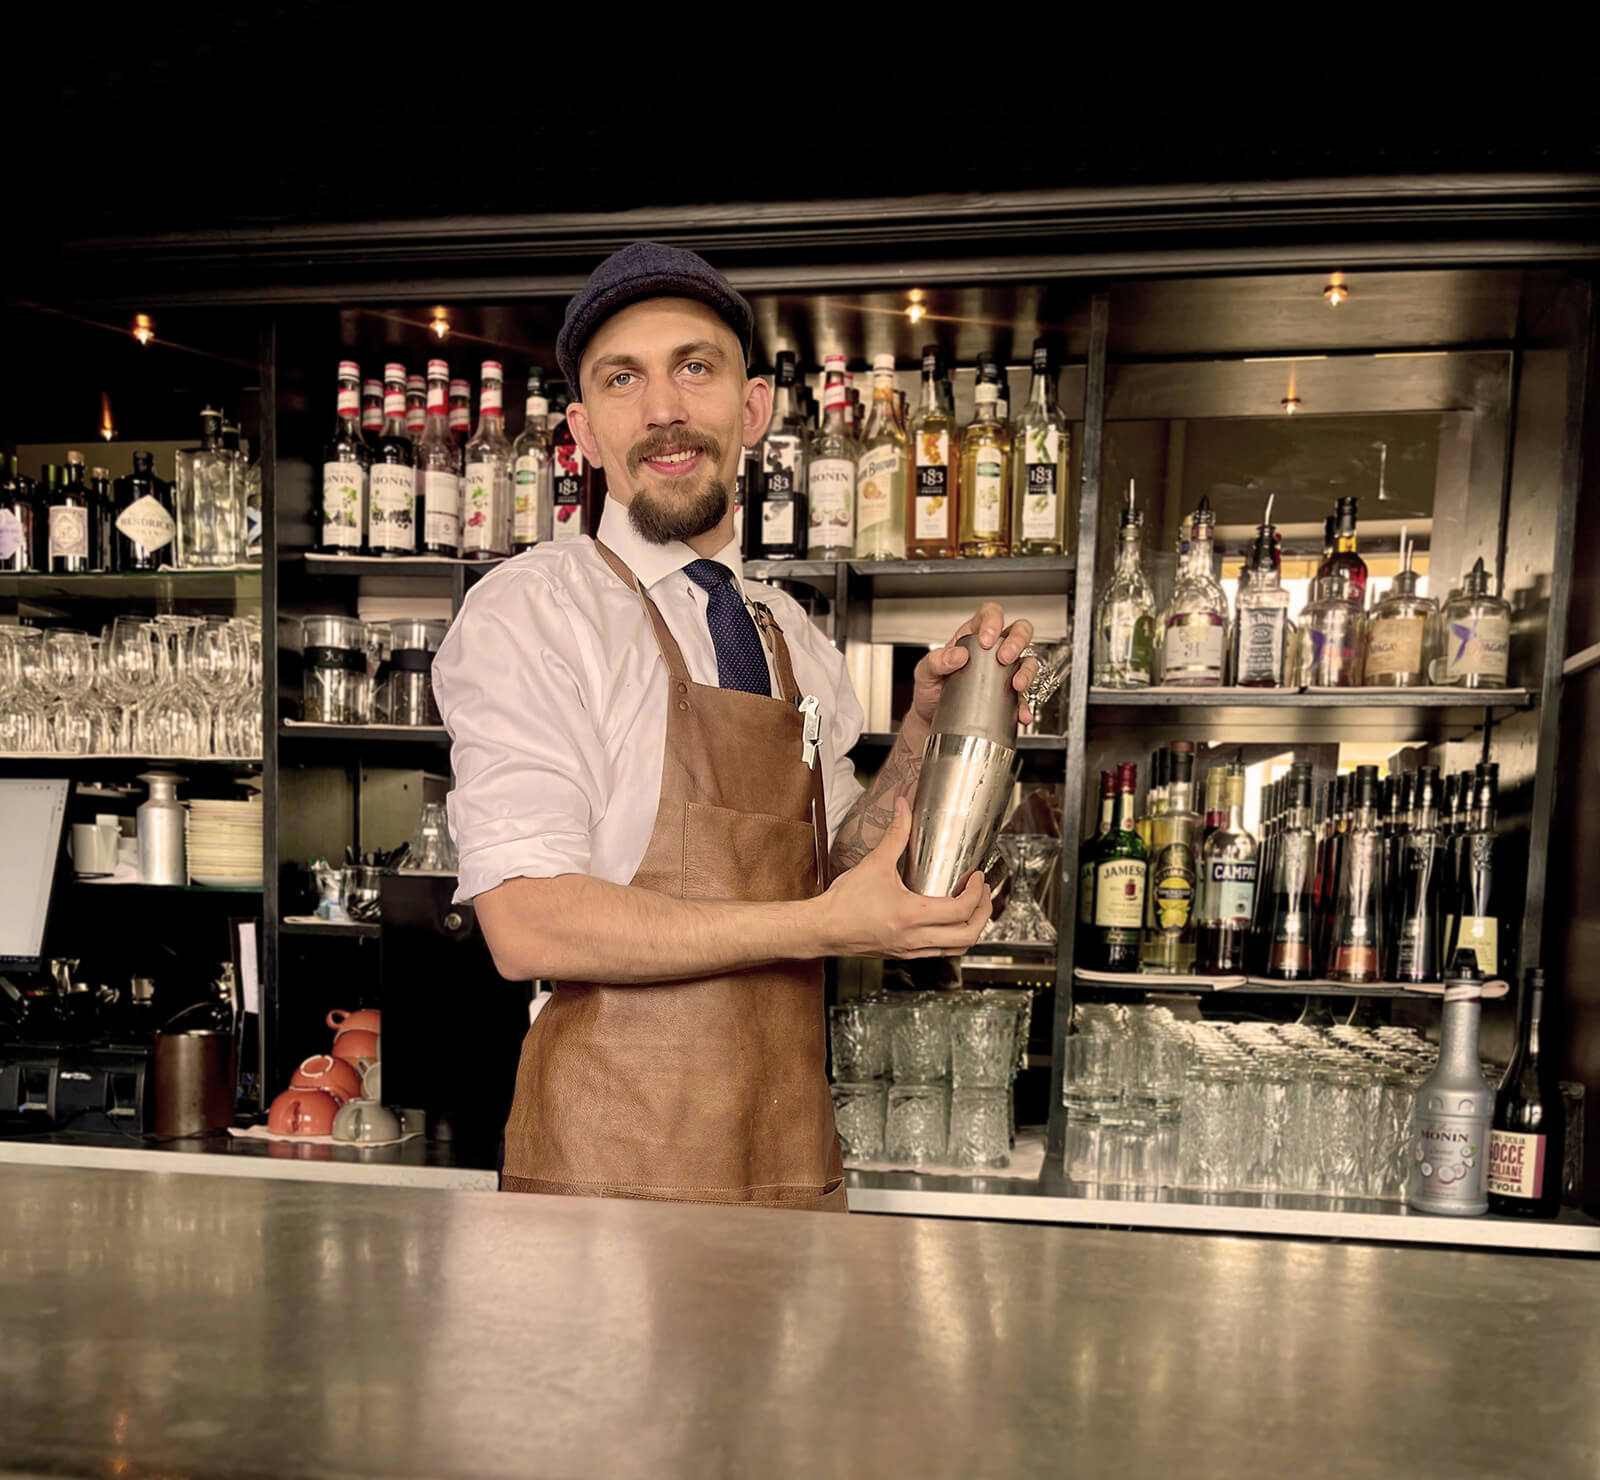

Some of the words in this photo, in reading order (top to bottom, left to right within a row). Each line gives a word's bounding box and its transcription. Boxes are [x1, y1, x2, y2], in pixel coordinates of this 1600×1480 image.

[1103, 864, 1146, 880] JAMES
[1213, 864, 1257, 881] CAMPA
[1421, 1128, 1470, 1144] MONIN
